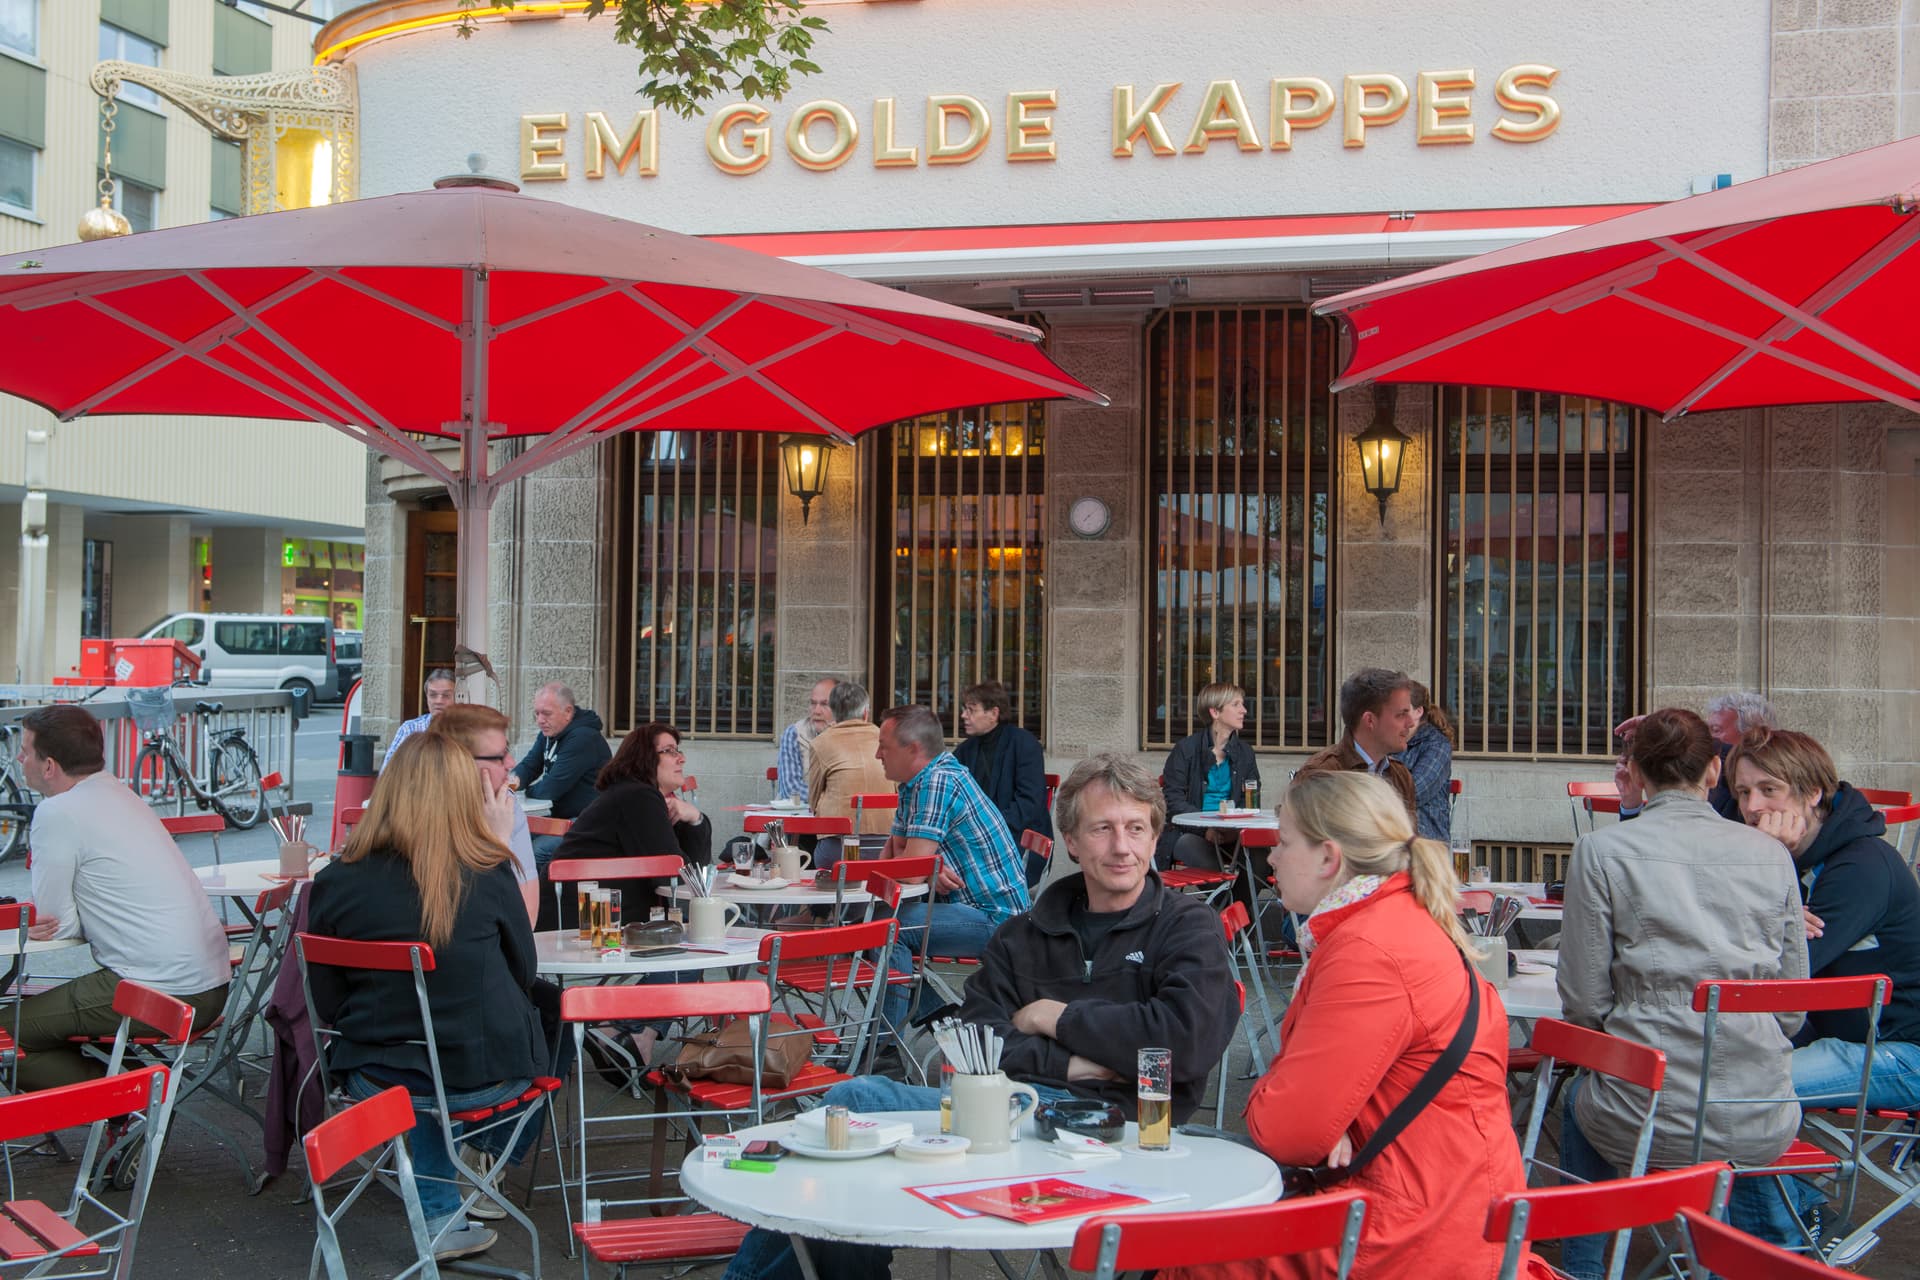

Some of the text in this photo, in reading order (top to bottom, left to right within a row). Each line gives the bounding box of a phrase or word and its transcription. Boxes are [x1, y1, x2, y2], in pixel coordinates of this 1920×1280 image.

[521, 64, 1561, 182] EM GOLDE KAPPES
